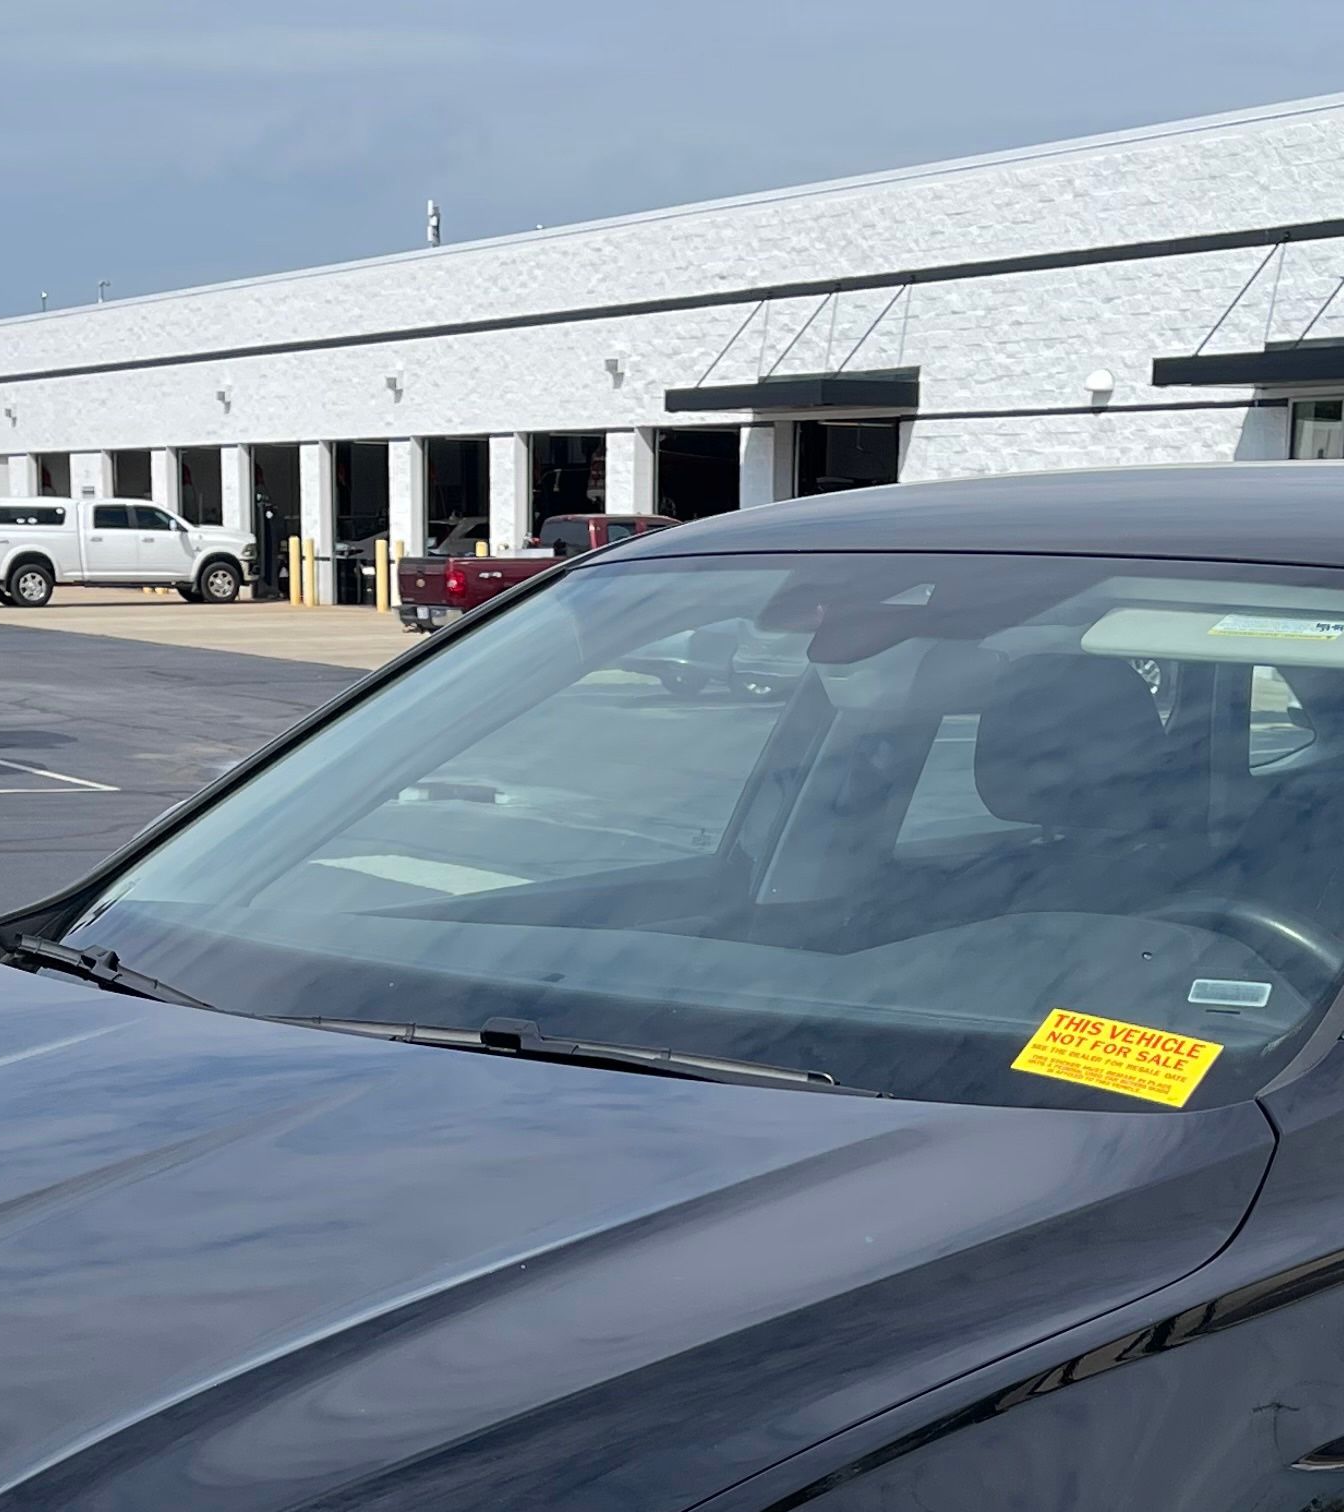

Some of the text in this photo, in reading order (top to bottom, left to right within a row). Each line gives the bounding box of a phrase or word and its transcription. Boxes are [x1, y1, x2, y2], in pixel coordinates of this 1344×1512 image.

[1045, 1030, 1188, 1071] NOT FOR SALE
[1053, 1013, 1206, 1060] THIS VEHICLE
[1049, 1046, 1069, 1056] THE
[1068, 1050, 1103, 1063] DEALER
[1103, 1058, 1125, 1069] FOR
